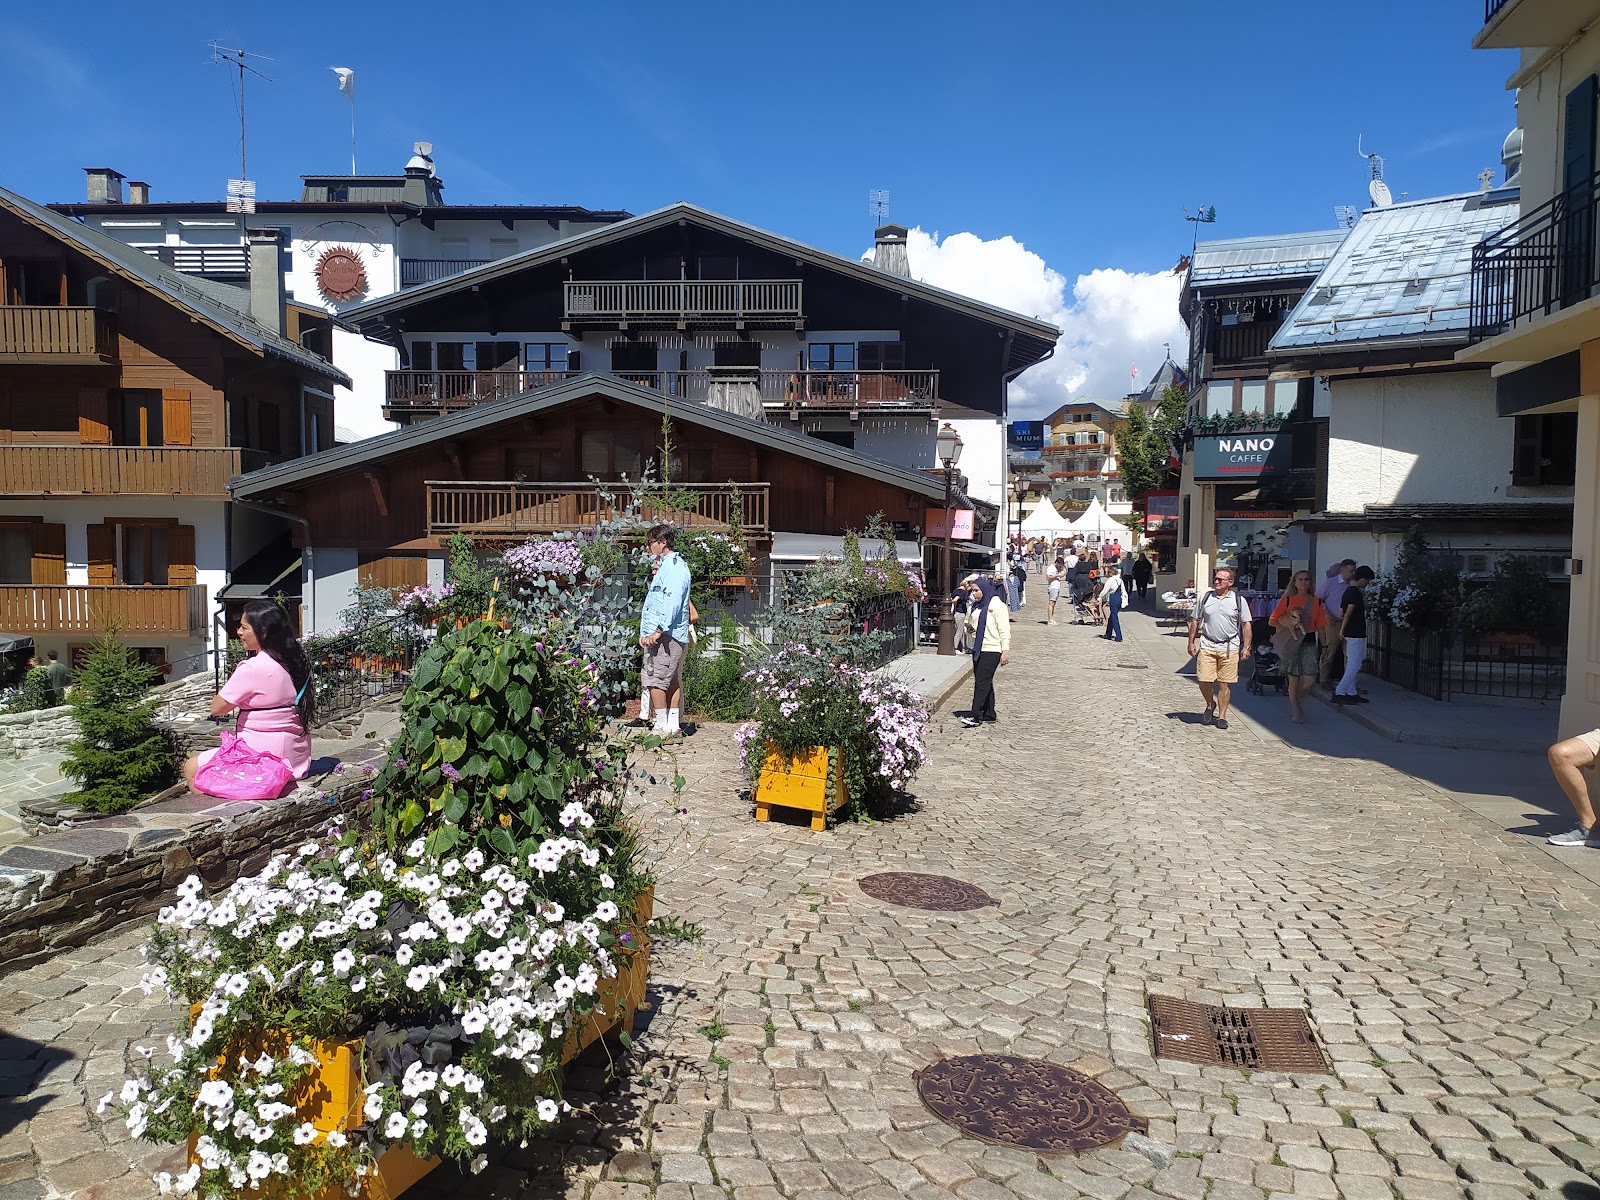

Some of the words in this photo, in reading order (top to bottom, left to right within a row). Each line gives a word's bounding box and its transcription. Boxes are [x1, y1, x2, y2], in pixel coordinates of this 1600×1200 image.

[1219, 438, 1275, 452] NANO
[1230, 454, 1262, 463] CAFFE
[935, 521, 970, 530] Arando
